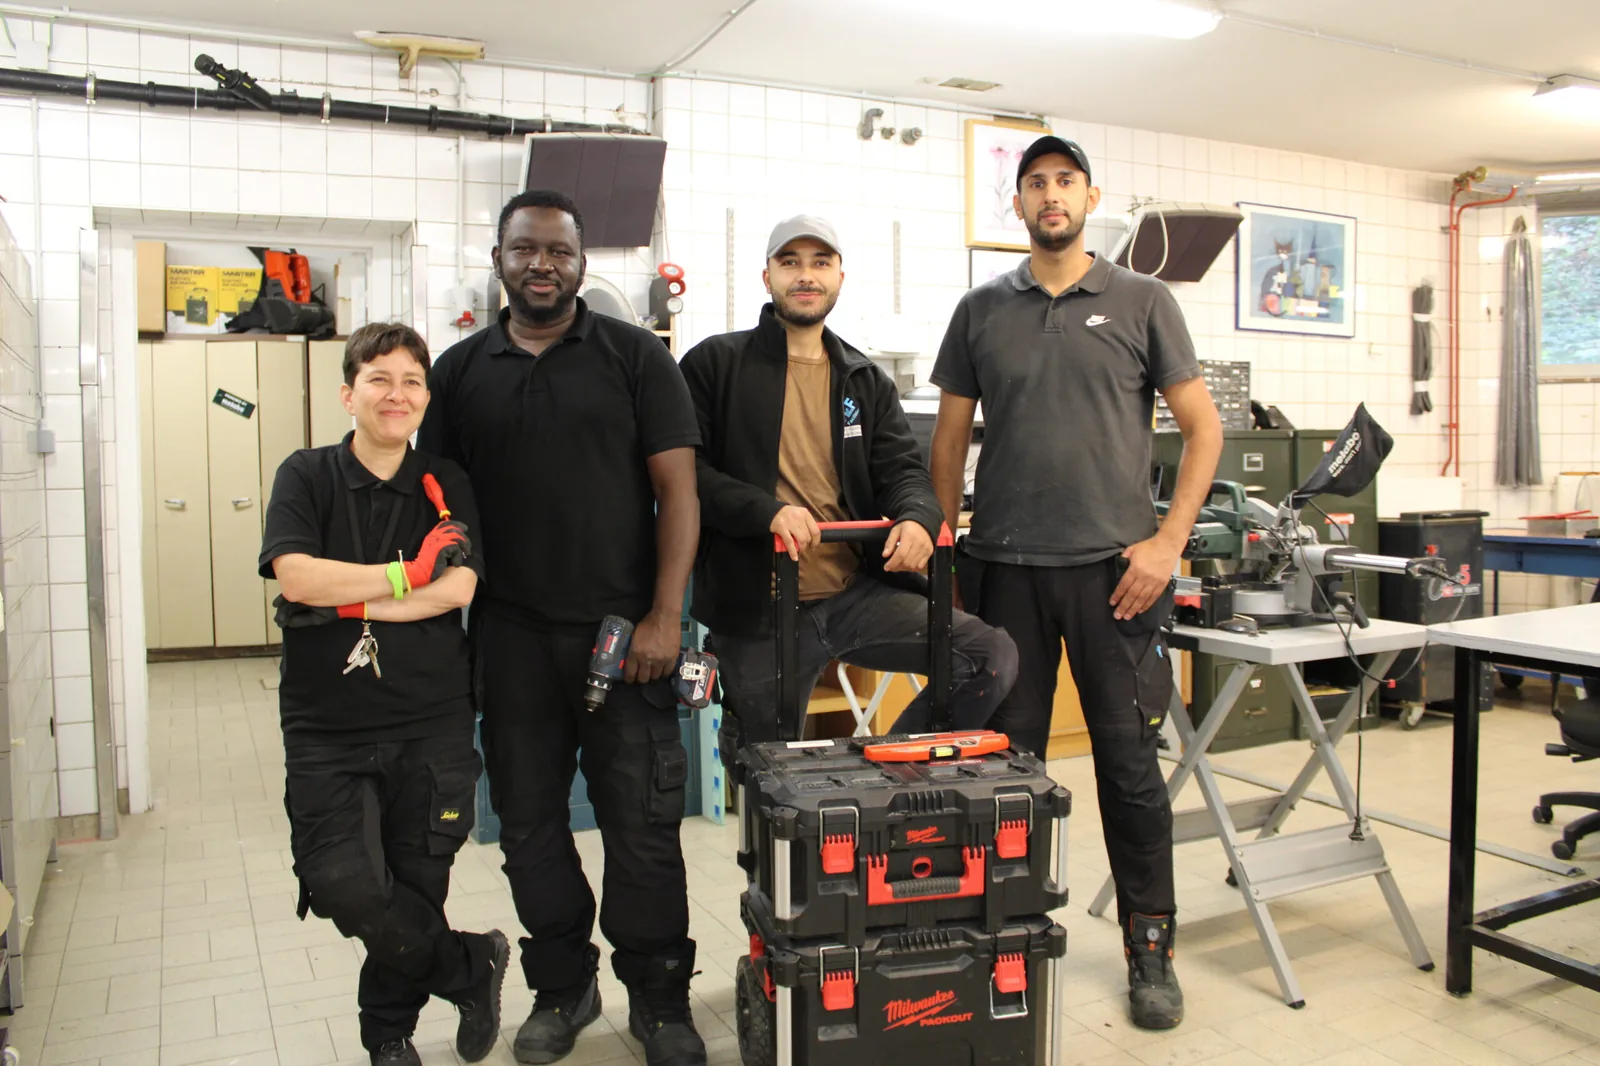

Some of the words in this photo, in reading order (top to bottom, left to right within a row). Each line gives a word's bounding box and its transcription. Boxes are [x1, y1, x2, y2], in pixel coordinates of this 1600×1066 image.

[1328, 431, 1360, 474] metabo
[883, 990, 956, 1023] Milwaukee
[920, 1012, 974, 1027] PACKOUT
